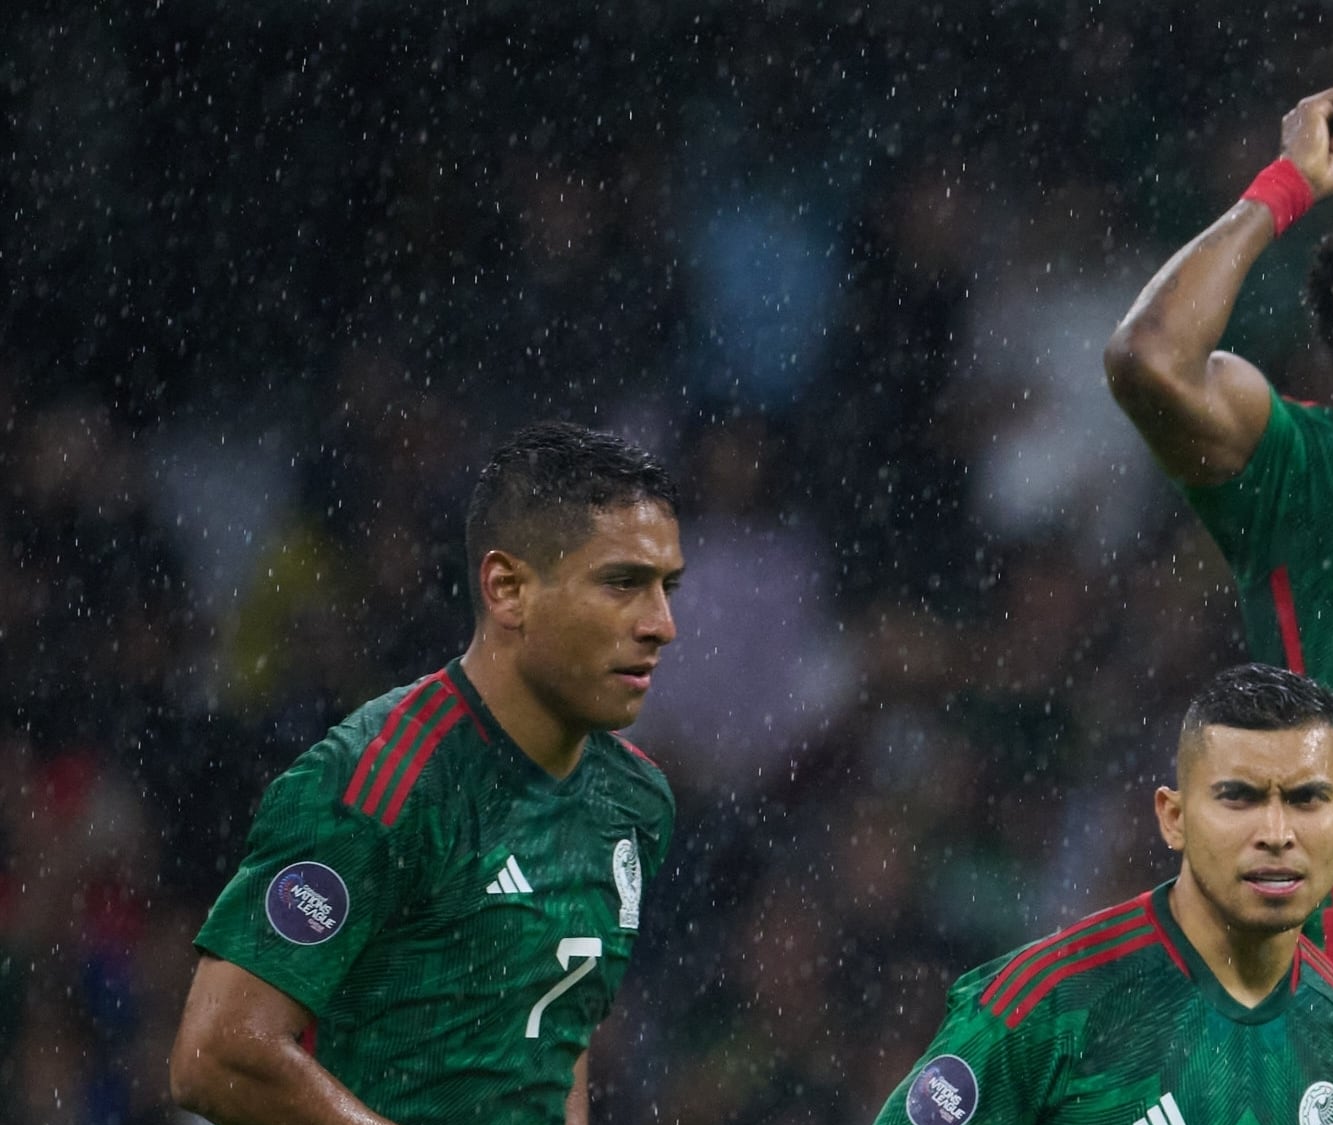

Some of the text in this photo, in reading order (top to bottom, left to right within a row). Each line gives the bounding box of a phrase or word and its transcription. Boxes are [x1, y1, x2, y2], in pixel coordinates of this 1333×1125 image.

[290, 884, 333, 915] NATIONS
[297, 901, 337, 929] LEAGUE
[525, 937, 602, 1038] 7
